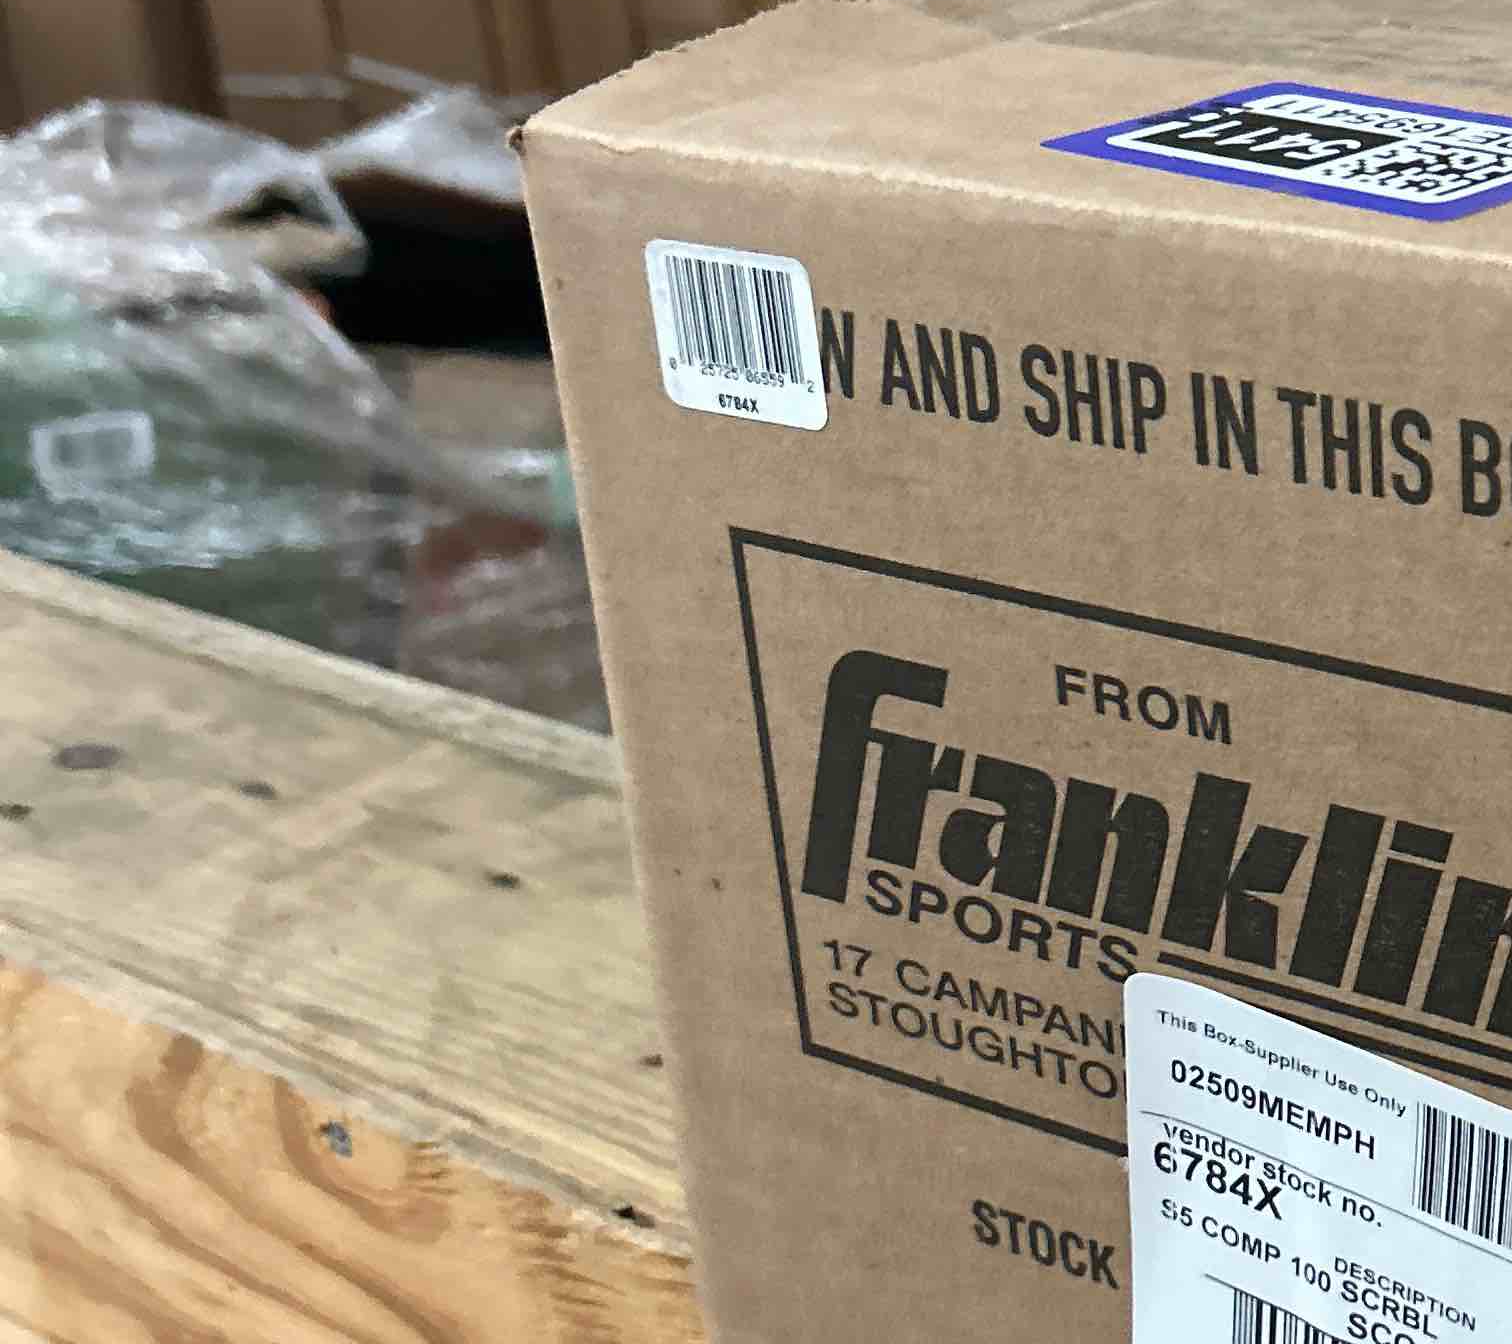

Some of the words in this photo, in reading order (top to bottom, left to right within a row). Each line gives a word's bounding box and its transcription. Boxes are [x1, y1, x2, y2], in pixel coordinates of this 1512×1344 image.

[1182, 121, 1362, 159] 5411
[701, 361, 741, 381] 25725
[806, 380, 816, 393] 2
[718, 393, 760, 415] 6784X
[881, 318, 1000, 424] AND
[1021, 344, 1167, 454] SHIP
[1192, 371, 1260, 475] IN
[1277, 387, 1433, 506] THIS
[1055, 664, 1232, 745] FROM
[864, 869, 1138, 984] SPORTS
[823, 939, 872, 977] 17
[895, 958, 1126, 1058] CAMPAN
[828, 981, 1127, 1104] STOUGHTO
[1157, 1009, 1198, 1034] This
[1203, 1022, 1320, 1079] Box-Supplier
[1324, 1069, 1359, 1096] Use
[1364, 1087, 1407, 1118] Only
[1170, 1058, 1376, 1160] 02509MEMPH
[1153, 1140, 1283, 1221] 6784X
[1163, 1122, 1256, 1170] vendor
[1262, 1160, 1332, 1207] stock
[1341, 1195, 1383, 1228] no.
[973, 1199, 1120, 1290] STOCK
[1200, 1215, 1282, 1263] COMP
[1290, 1256, 1332, 1293] 100
[1340, 1280, 1439, 1340] SCRBL
[1333, 1256, 1477, 1332] DESCRIPTION
